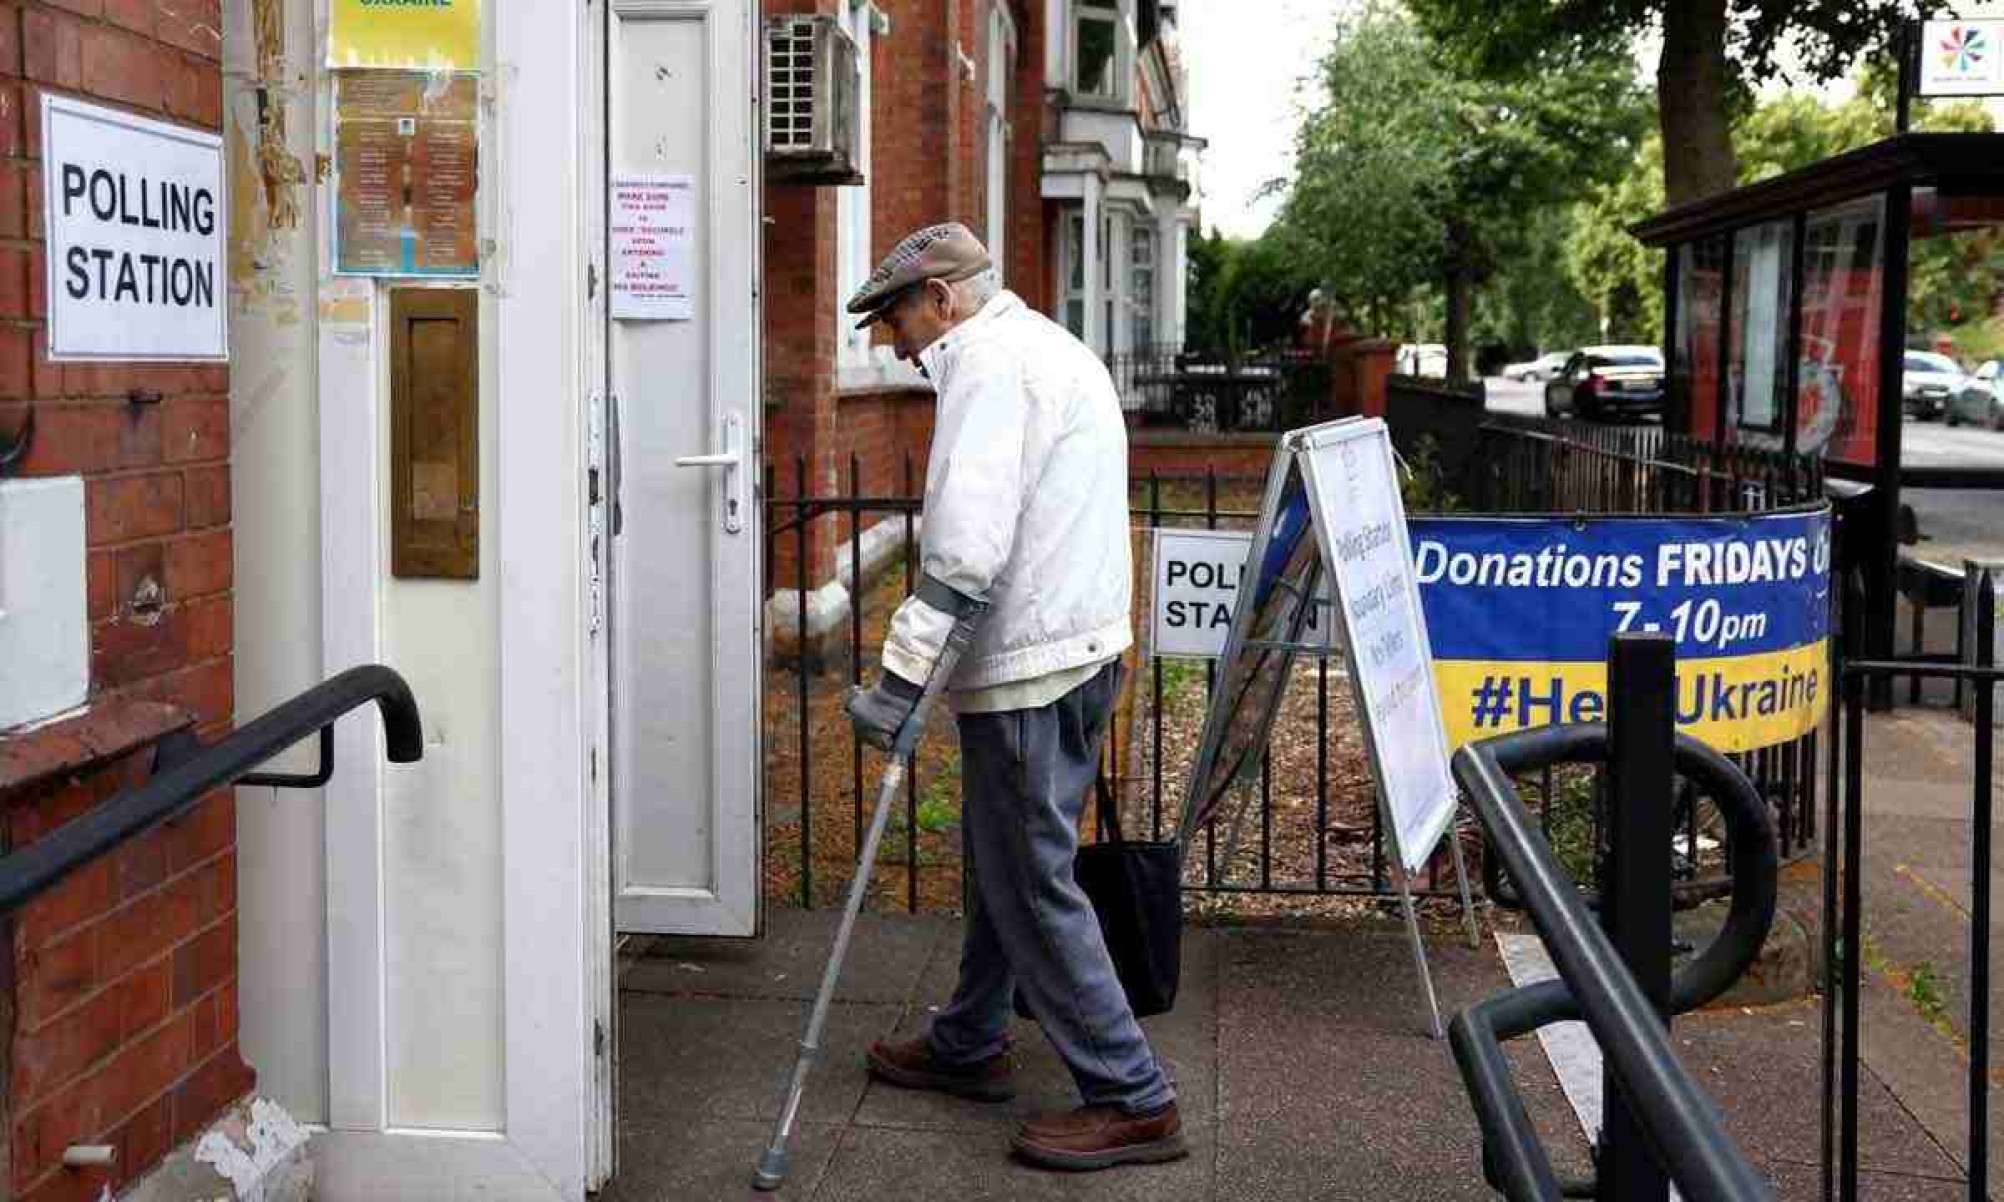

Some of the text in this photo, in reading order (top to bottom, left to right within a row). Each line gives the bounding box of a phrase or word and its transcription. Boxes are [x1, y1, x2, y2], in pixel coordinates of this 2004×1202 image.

[62, 163, 214, 236] POLLING
[65, 246, 213, 308] STATION
[1415, 541, 1642, 588] Donations
[1656, 536, 1806, 588] FRIDAYS
